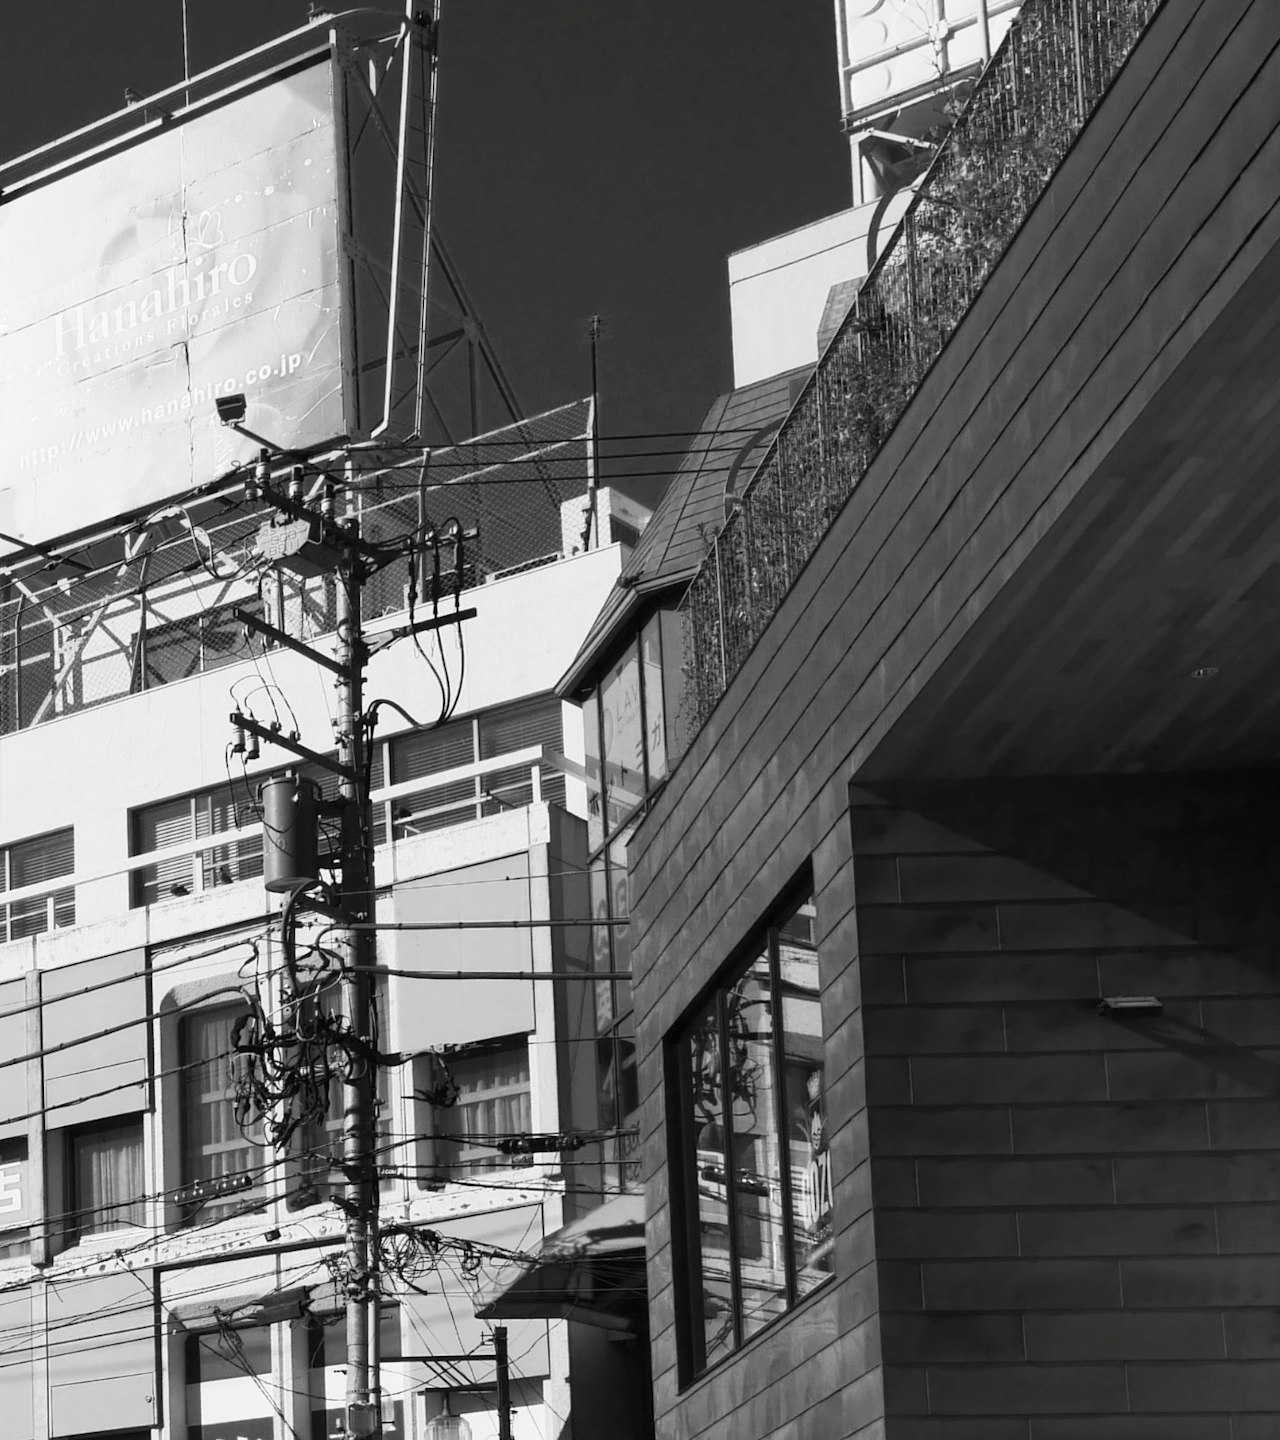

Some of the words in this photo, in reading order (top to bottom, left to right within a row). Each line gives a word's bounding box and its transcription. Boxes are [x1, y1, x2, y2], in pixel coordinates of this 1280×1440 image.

[53, 252, 258, 360] Hanahiro
[166, 291, 255, 336] Florales
[18, 350, 303, 470] http://www.hanahiro.co.jp
